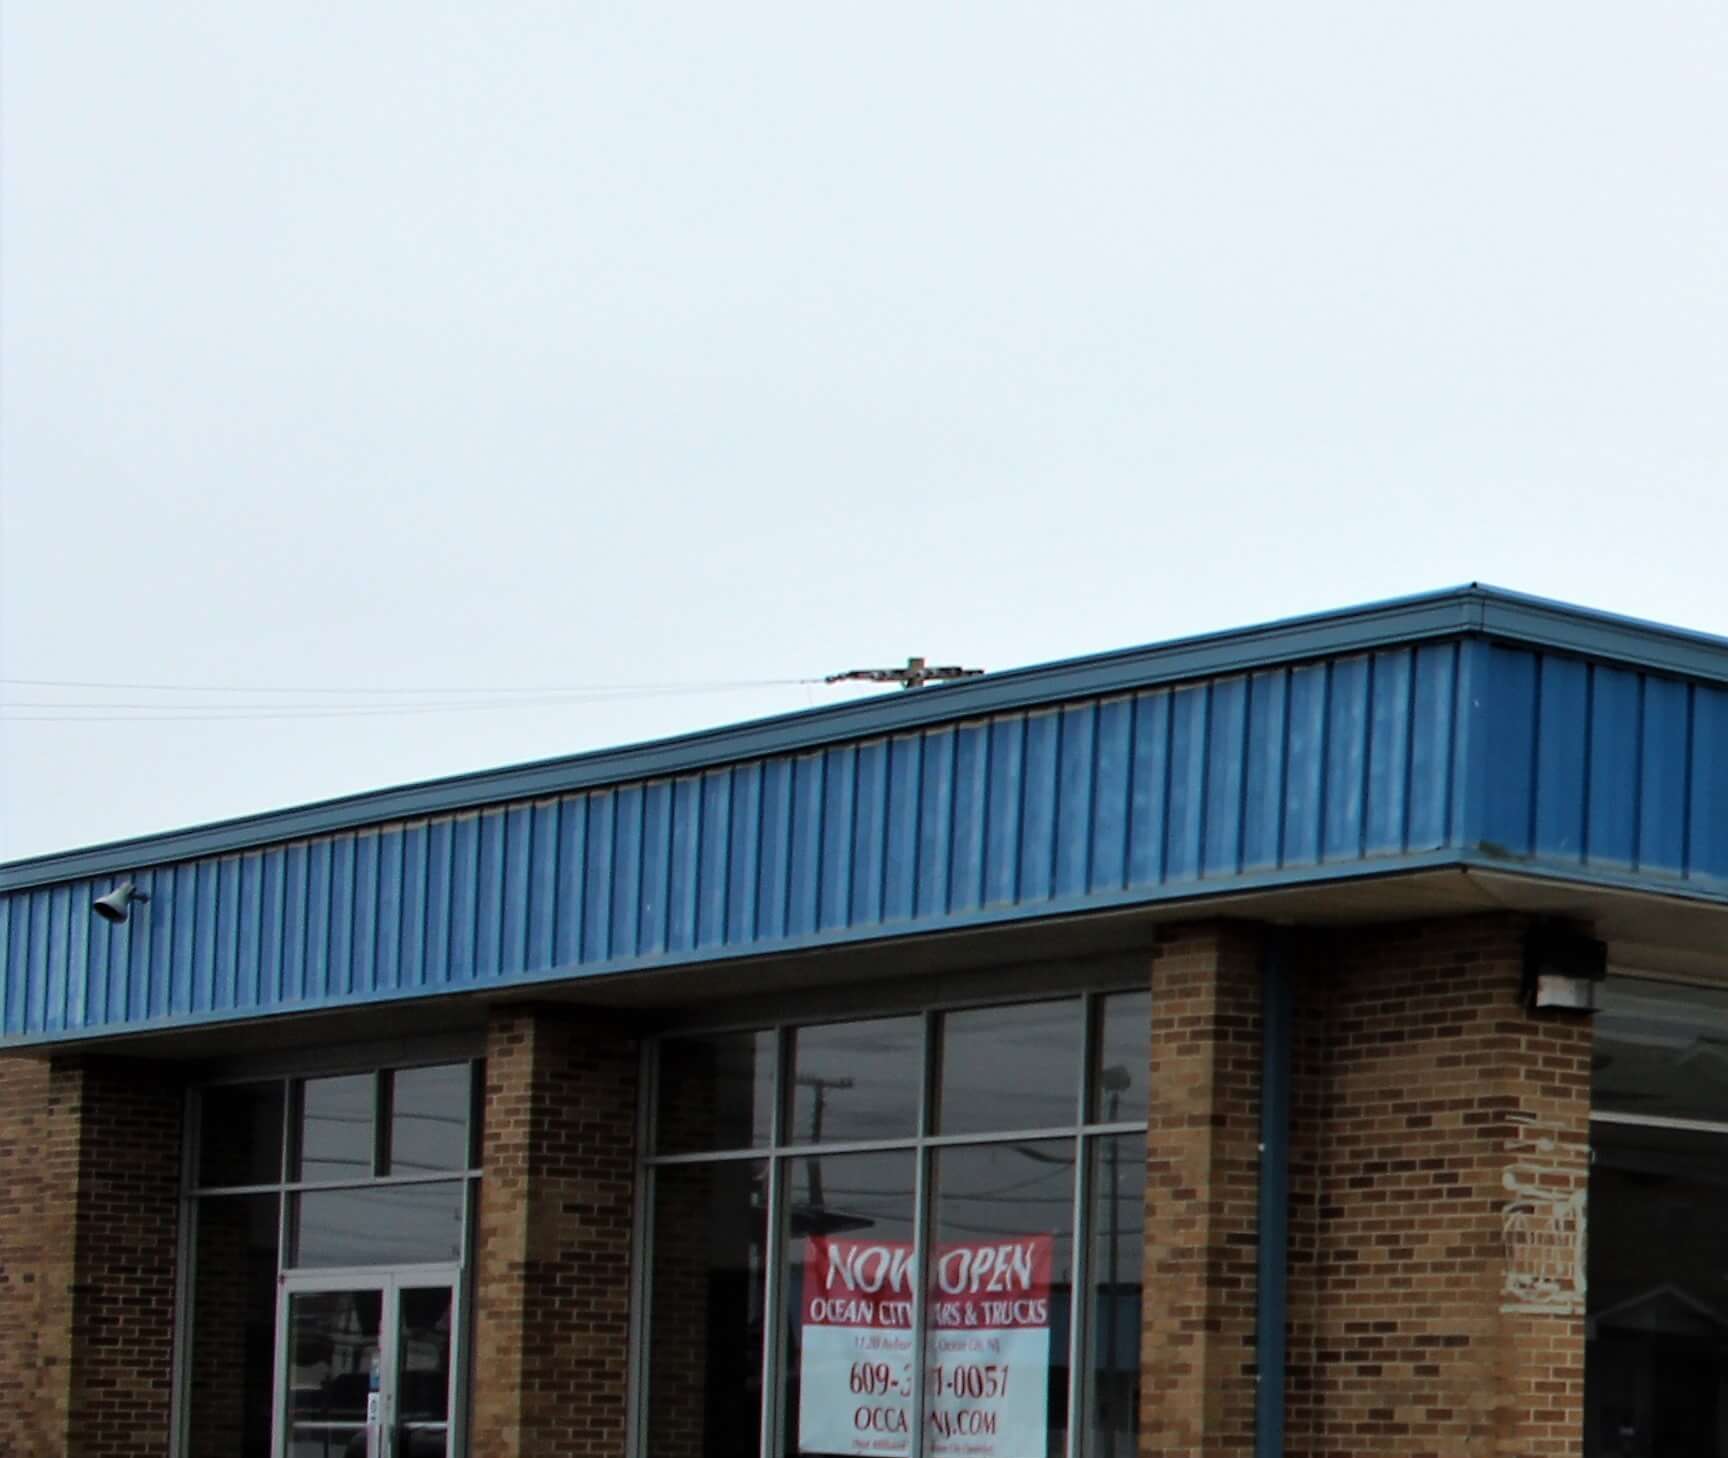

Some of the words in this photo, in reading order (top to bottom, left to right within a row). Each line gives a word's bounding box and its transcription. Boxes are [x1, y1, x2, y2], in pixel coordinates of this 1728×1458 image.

[937, 1243, 1034, 1295] OPEN
[810, 1297, 873, 1323] OCEAN
[963, 1302, 977, 1326] &
[980, 1299, 1048, 1325] TRUCKS
